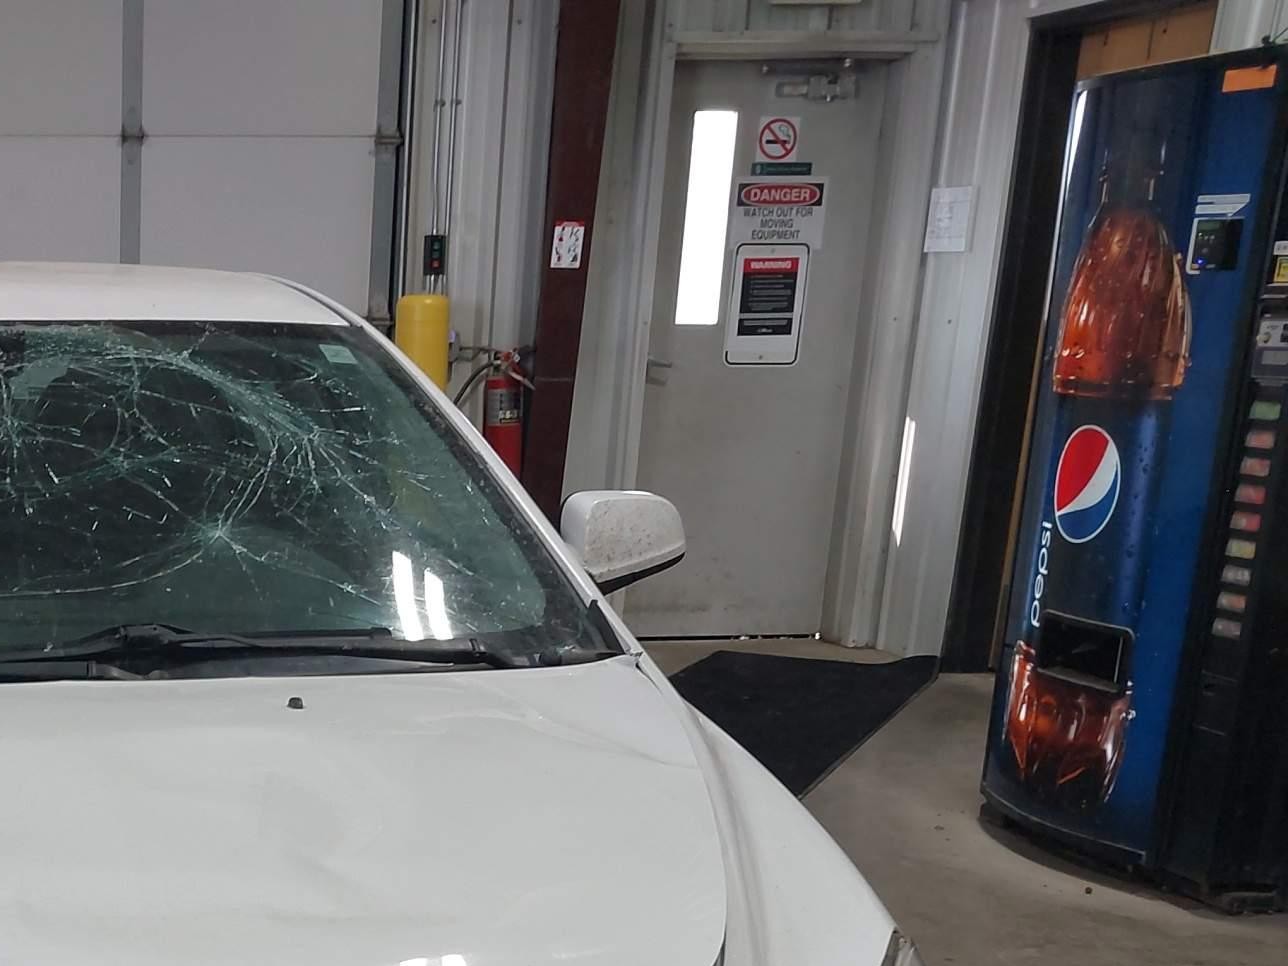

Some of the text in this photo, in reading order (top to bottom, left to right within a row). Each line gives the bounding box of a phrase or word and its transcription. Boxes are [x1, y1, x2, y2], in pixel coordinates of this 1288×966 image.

[750, 188, 810, 202] DANGER
[743, 207, 814, 218] WATCH OUT FOR
[760, 218, 794, 229] MOVING
[751, 229, 800, 240] EQUIPMENT
[1030, 521, 1053, 628] pepsi
